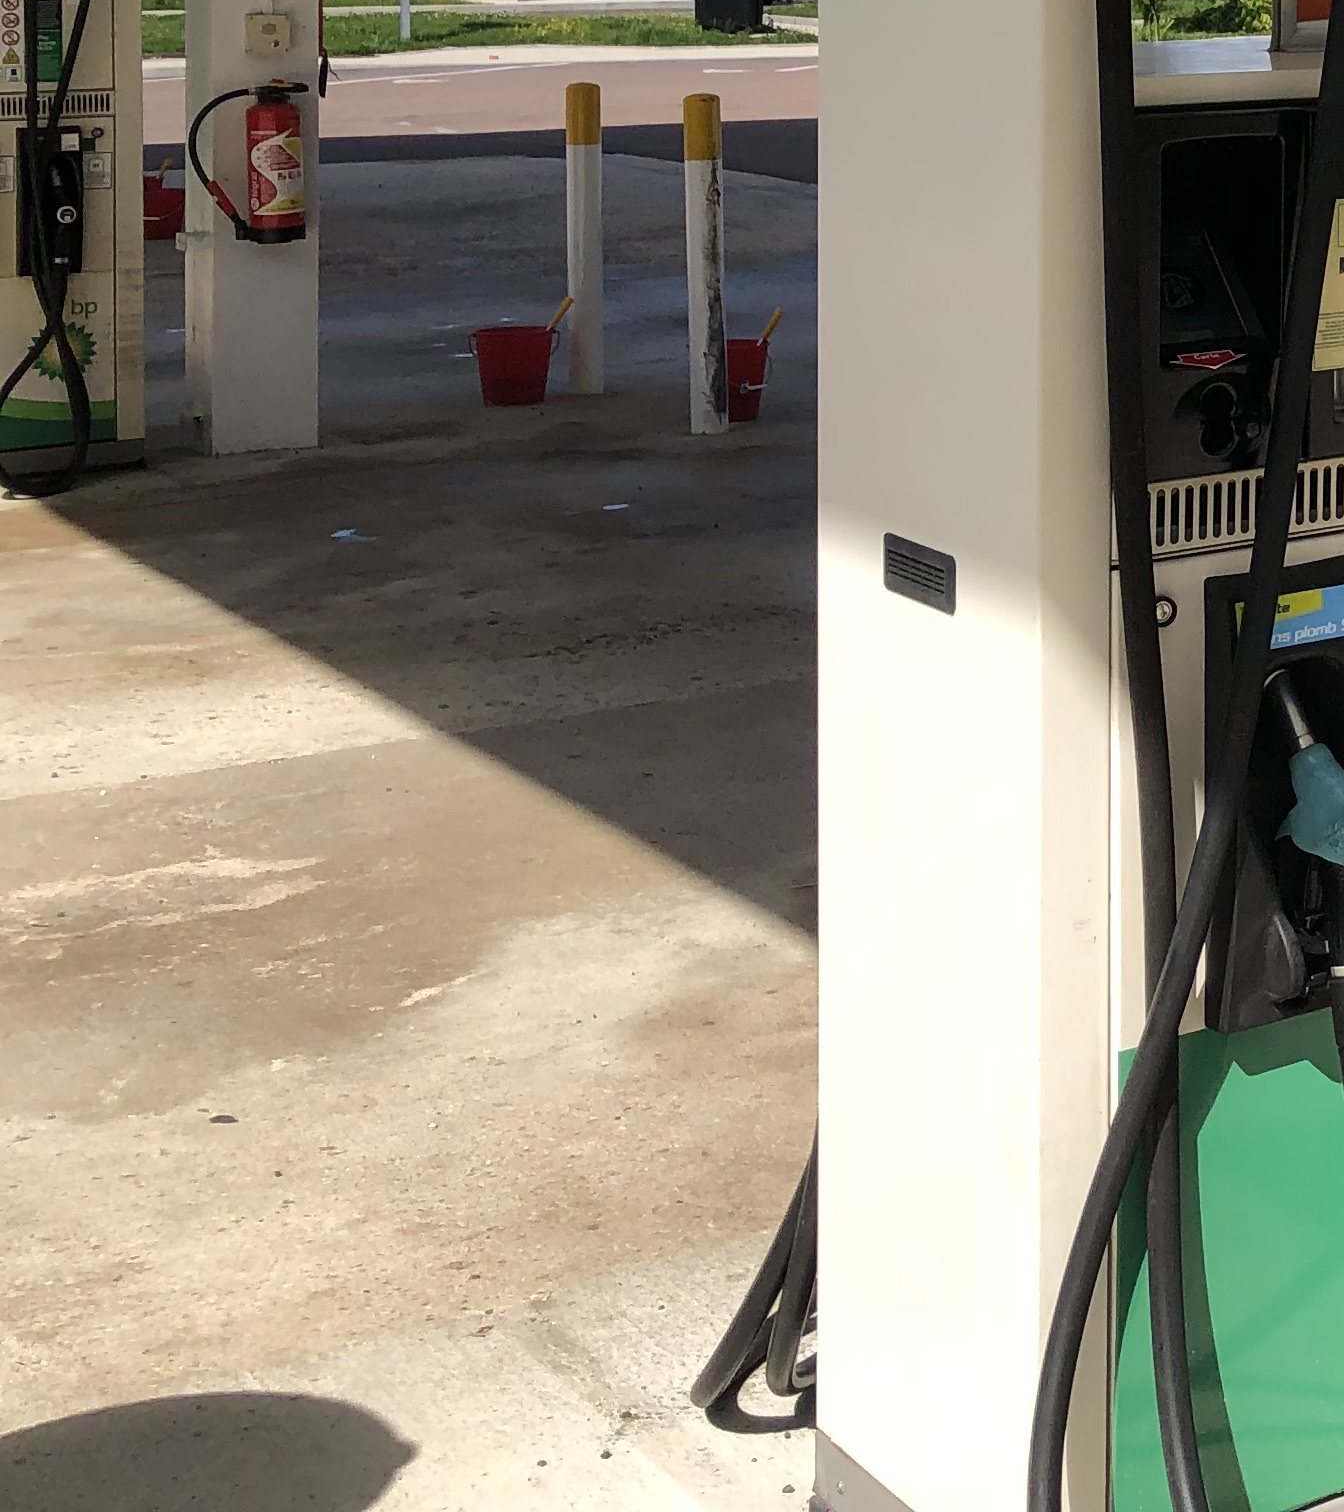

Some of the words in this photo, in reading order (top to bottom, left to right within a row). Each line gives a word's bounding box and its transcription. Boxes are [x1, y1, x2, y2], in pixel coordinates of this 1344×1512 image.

[71, 299, 98, 318] bp
[1272, 631, 1290, 644] ns
[1295, 622, 1337, 643] plomb
